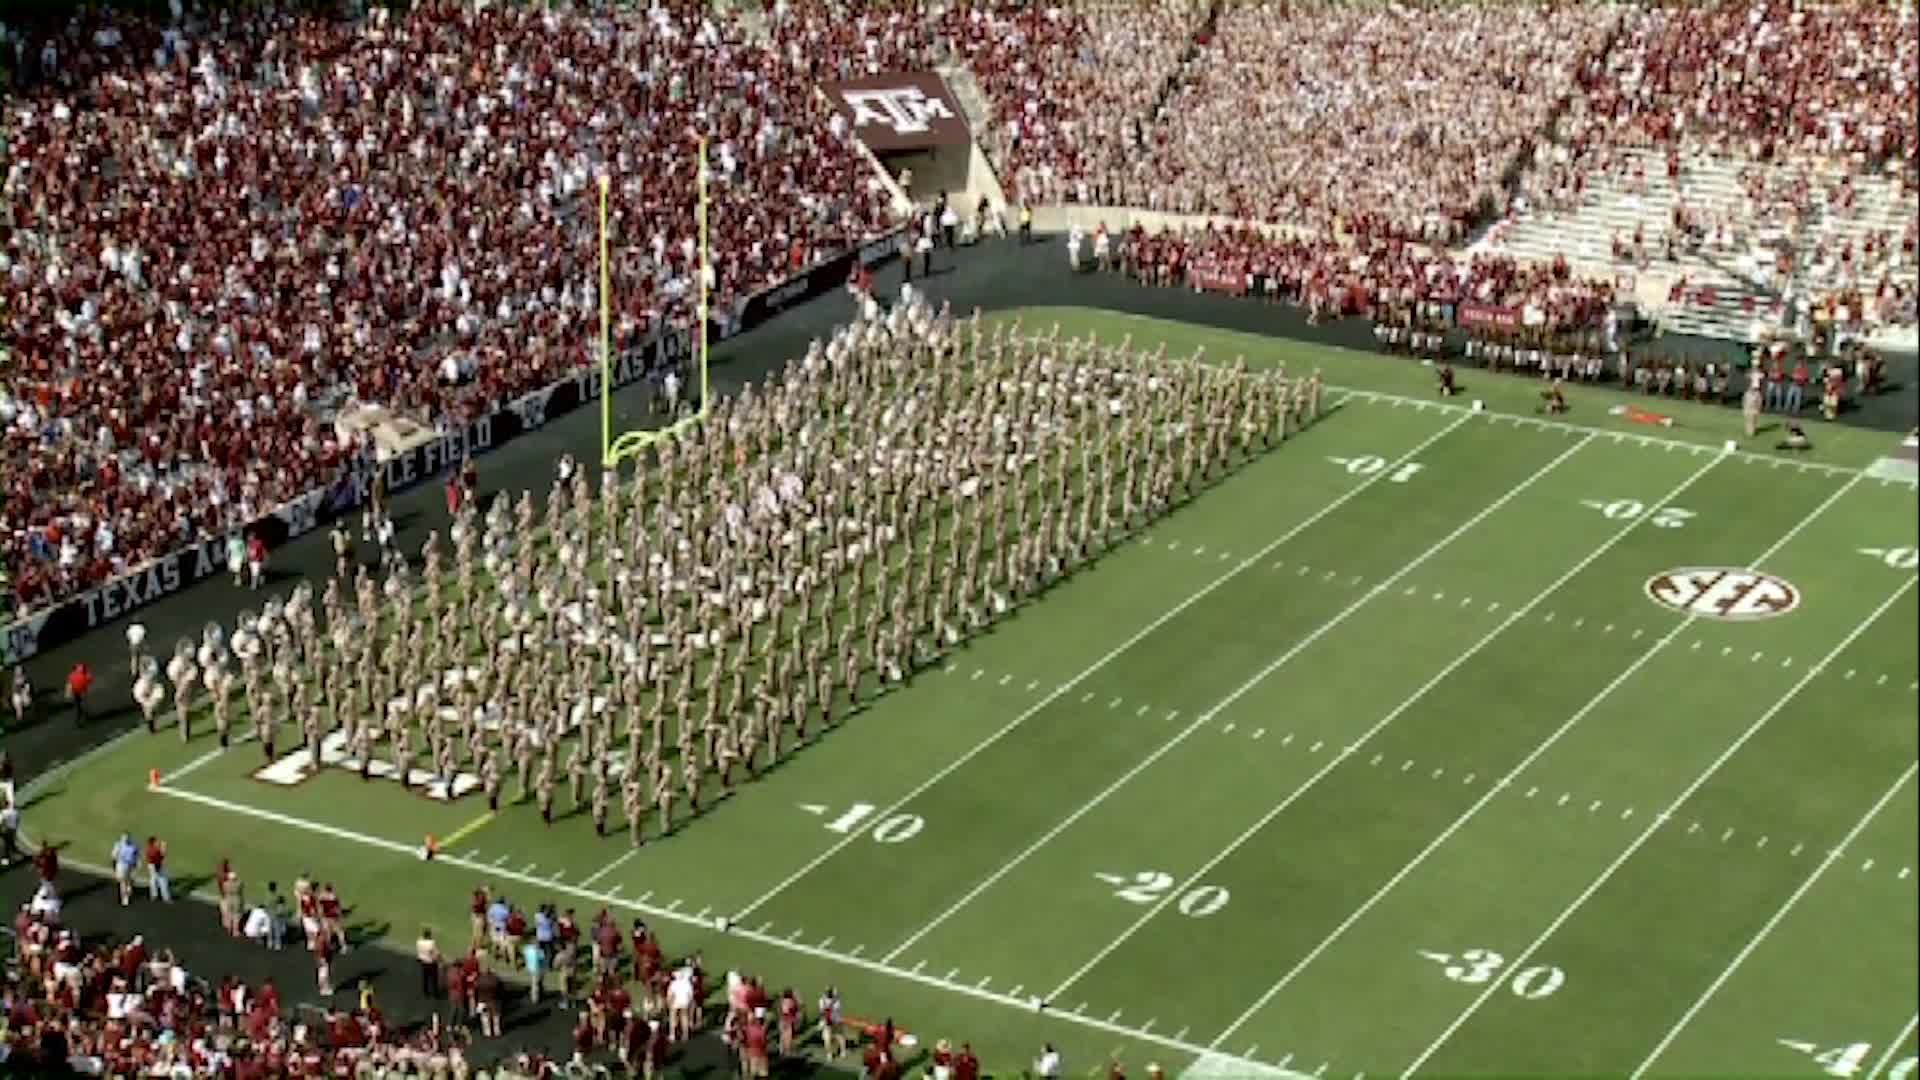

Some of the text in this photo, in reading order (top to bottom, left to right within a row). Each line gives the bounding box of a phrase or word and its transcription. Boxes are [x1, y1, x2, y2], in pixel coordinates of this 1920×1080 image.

[352, 452, 417, 505] KLE
[81, 555, 181, 627] TEXAS
[1648, 569, 1797, 617] SEC
